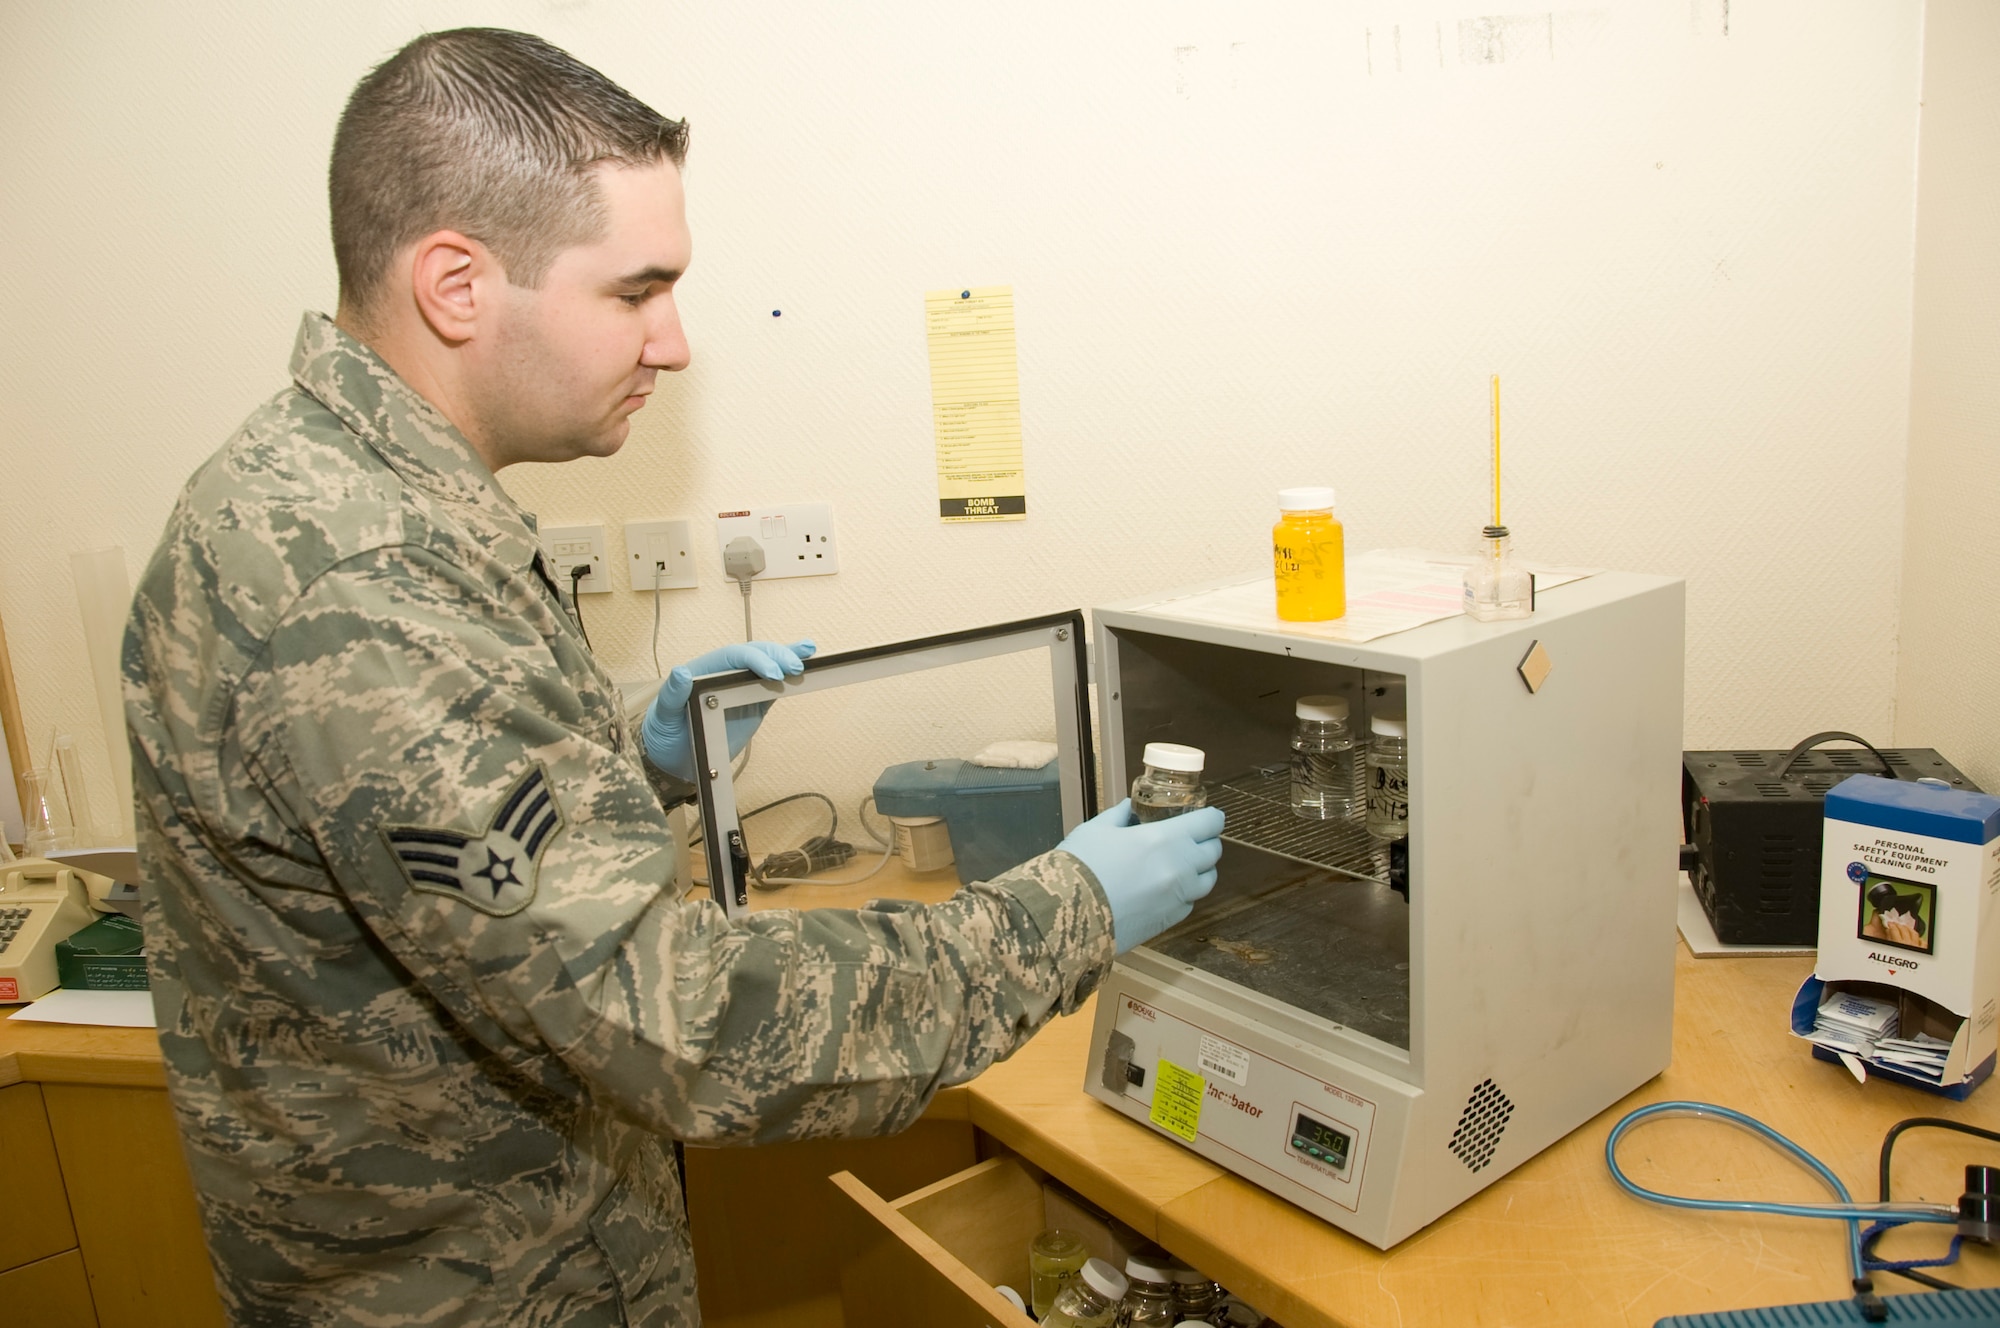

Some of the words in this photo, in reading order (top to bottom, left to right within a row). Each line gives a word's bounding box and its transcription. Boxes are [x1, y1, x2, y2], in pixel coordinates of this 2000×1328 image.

[964, 506, 1000, 514] THREAT
[968, 498, 995, 506] BOMB
[1852, 844, 1888, 856] SAFETY
[1890, 851, 1949, 868] EQUIPMENT
[1874, 839, 1926, 855] PERSONAL
[1863, 854, 1912, 870] CLEANING
[1915, 864, 1936, 874] PAD
[1868, 952, 1918, 970] ALLEGRO
[1133, 1002, 1156, 1020] BOEKEL
[1324, 1085, 1343, 1100] MODEL
[1296, 1155, 1338, 1180] TEMPERATURE
